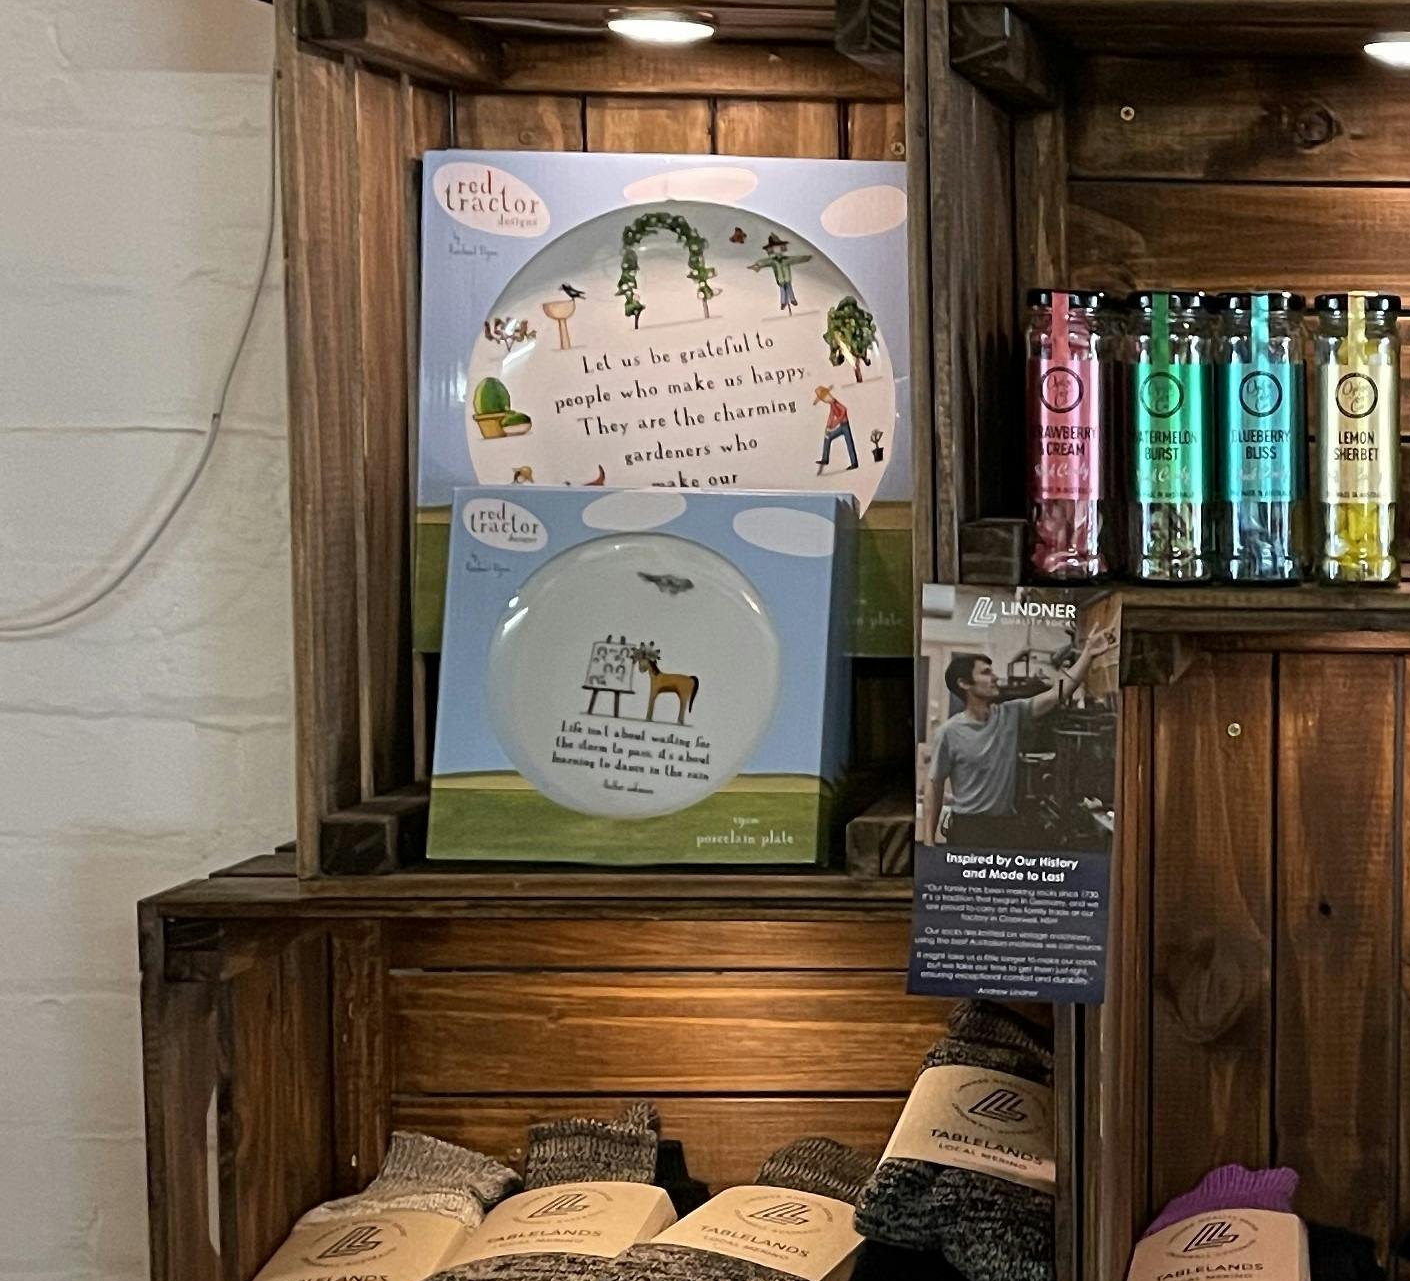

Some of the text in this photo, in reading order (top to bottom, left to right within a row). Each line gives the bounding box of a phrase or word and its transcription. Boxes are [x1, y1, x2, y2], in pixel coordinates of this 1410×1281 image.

[458, 170, 492, 194] red
[444, 183, 539, 214] tractor
[583, 332, 774, 375] Let us be grateful to
[555, 389, 611, 414] people
[620, 380, 658, 400] who
[668, 373, 715, 396] make
[725, 371, 743, 387] us
[577, 399, 797, 438] They are the charming
[1232, 429, 1290, 444] BLUEBERRY
[1338, 430, 1375, 445] LEMON
[624, 436, 758, 466] gardeners who
[1047, 442, 1084, 456] CREAM
[1145, 447, 1179, 461] BURST
[1246, 447, 1277, 460] BLISS
[1334, 447, 1378, 461] SHERBET
[709, 474, 737, 486] our
[479, 502, 506, 520] red
[471, 513, 539, 534] tractor
[1001, 601, 1076, 618] LINDNER
[696, 829, 795, 846] porcelain plate
[946, 852, 1078, 870] Inspired by Our History
[962, 869, 1064, 882] and Made to Last
[931, 1129, 1043, 1165] TABLELANDS
[700, 1225, 810, 1258] TABLELANDS
[1157, 1263, 1263, 1281] TABLELANDS
